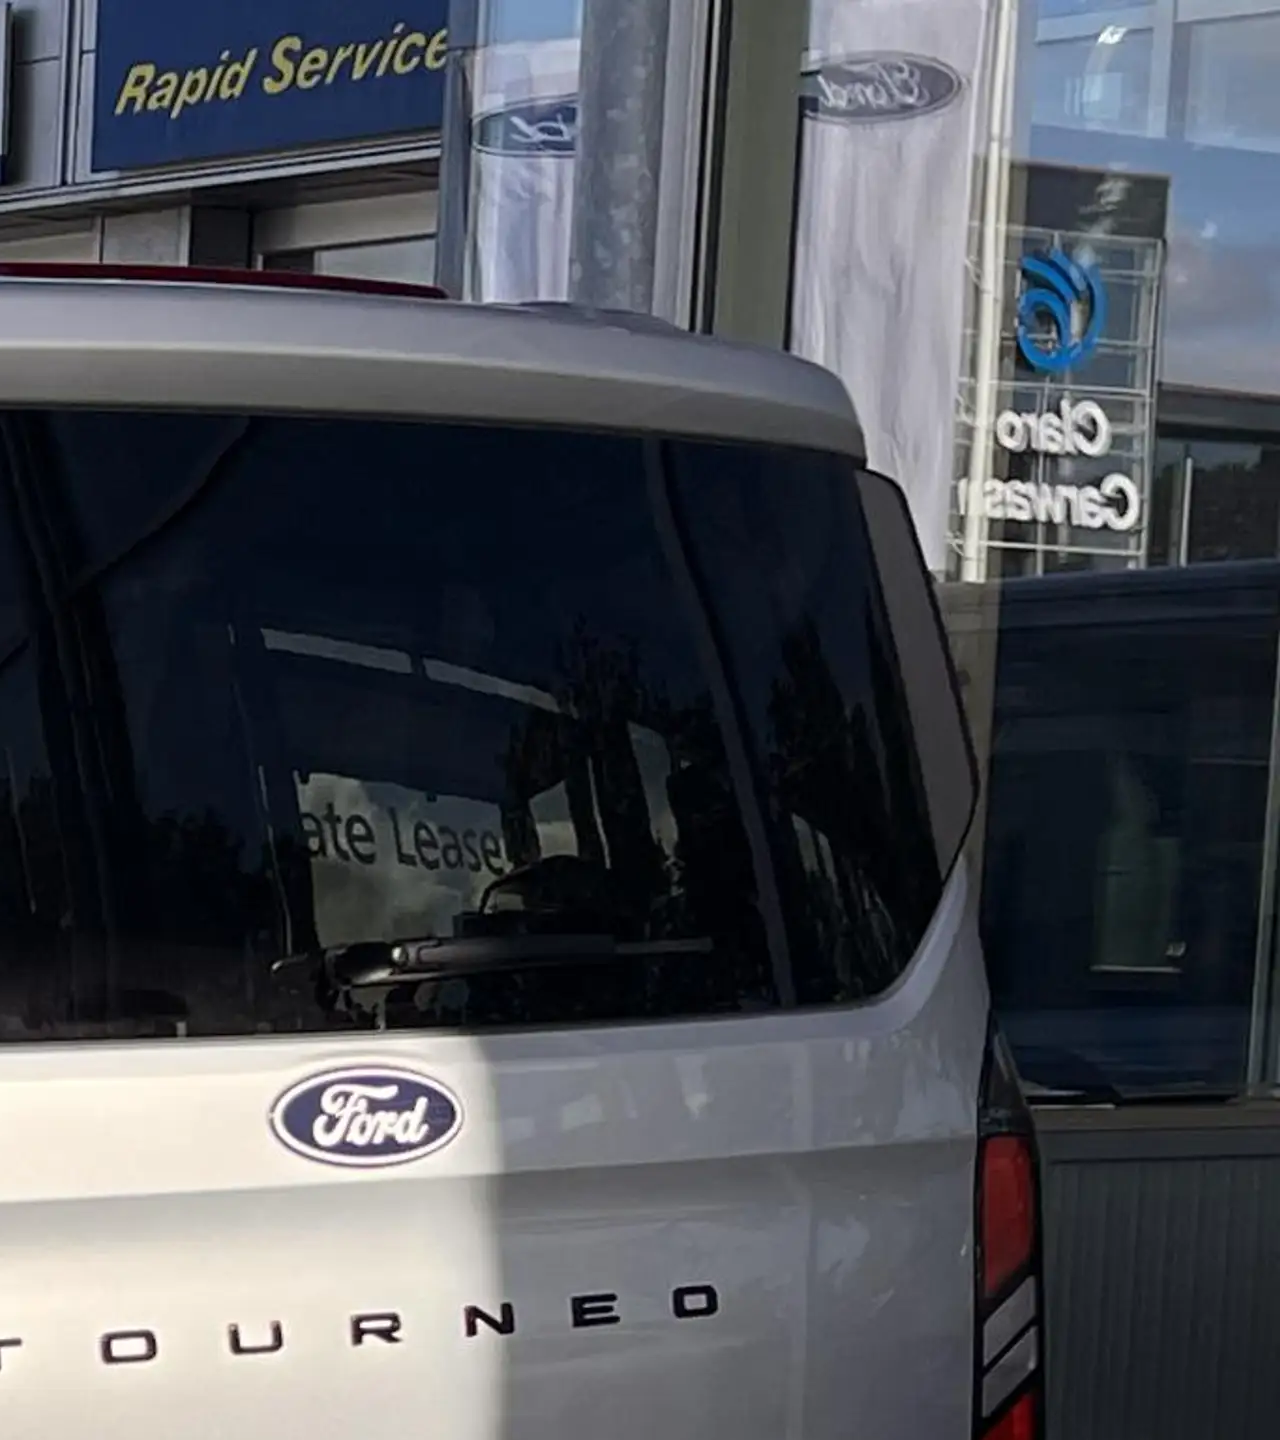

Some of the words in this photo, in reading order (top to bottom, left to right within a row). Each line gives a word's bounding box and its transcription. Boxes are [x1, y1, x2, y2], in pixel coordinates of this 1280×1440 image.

[115, 47, 258, 120] Rapid
[263, 22, 449, 95] Service
[390, 807, 505, 875] Lease
